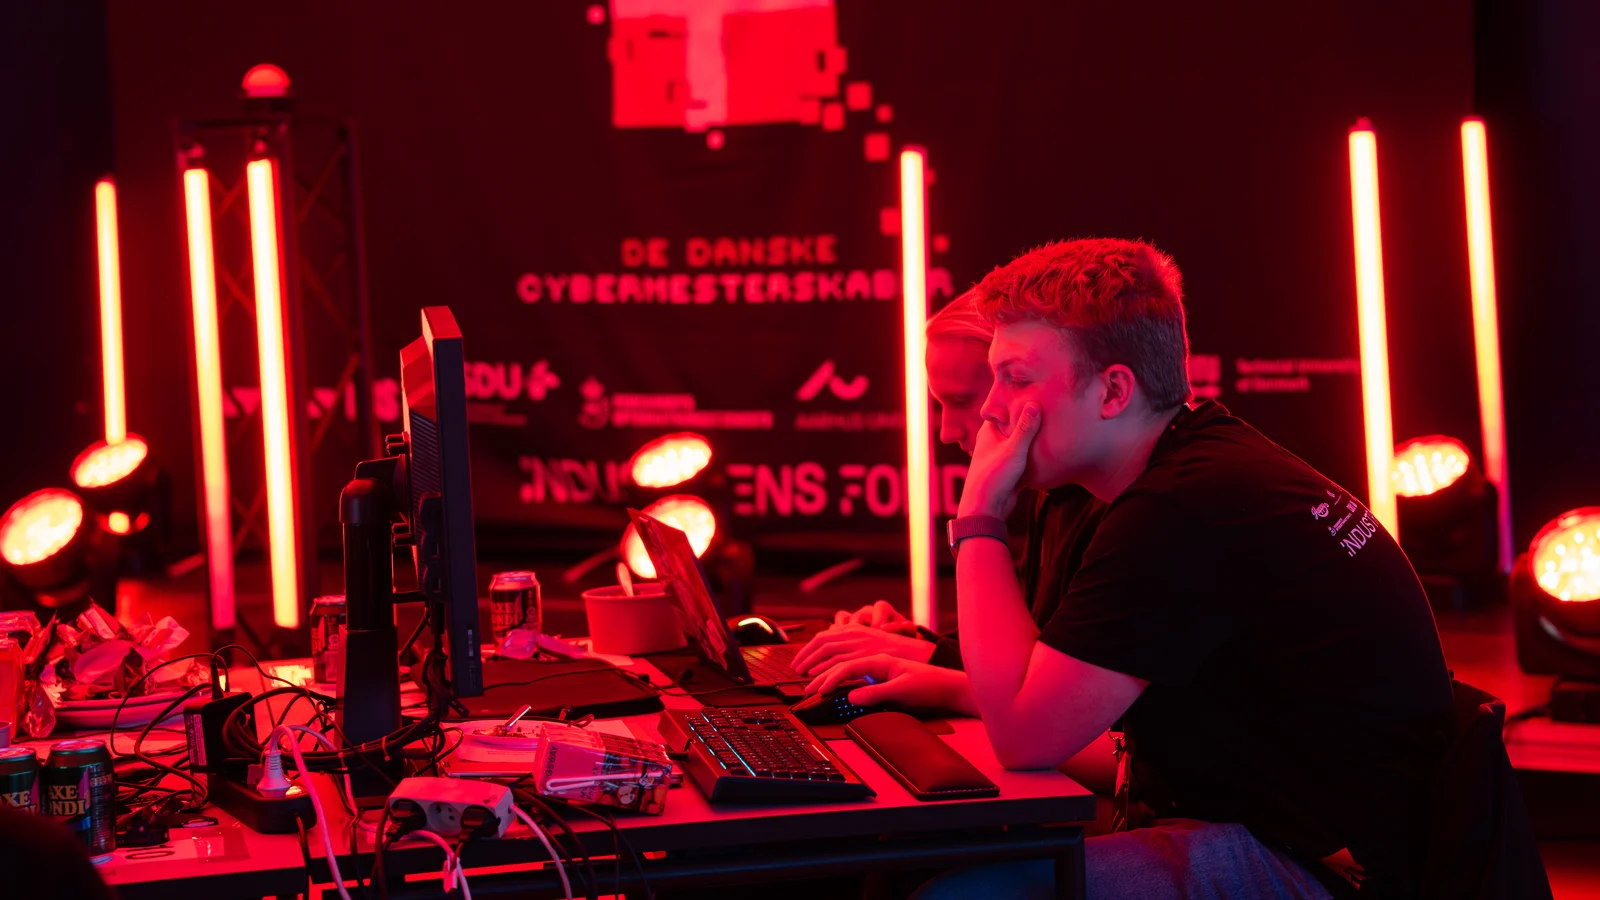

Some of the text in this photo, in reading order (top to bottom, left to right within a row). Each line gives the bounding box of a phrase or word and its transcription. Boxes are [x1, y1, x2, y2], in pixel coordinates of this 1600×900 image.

[621, 235, 837, 268] DE DANSKE
[517, 269, 953, 304] CYBERMESTERSKABR
[839, 463, 972, 517] FOD
[1340, 510, 1379, 557] INDUST
